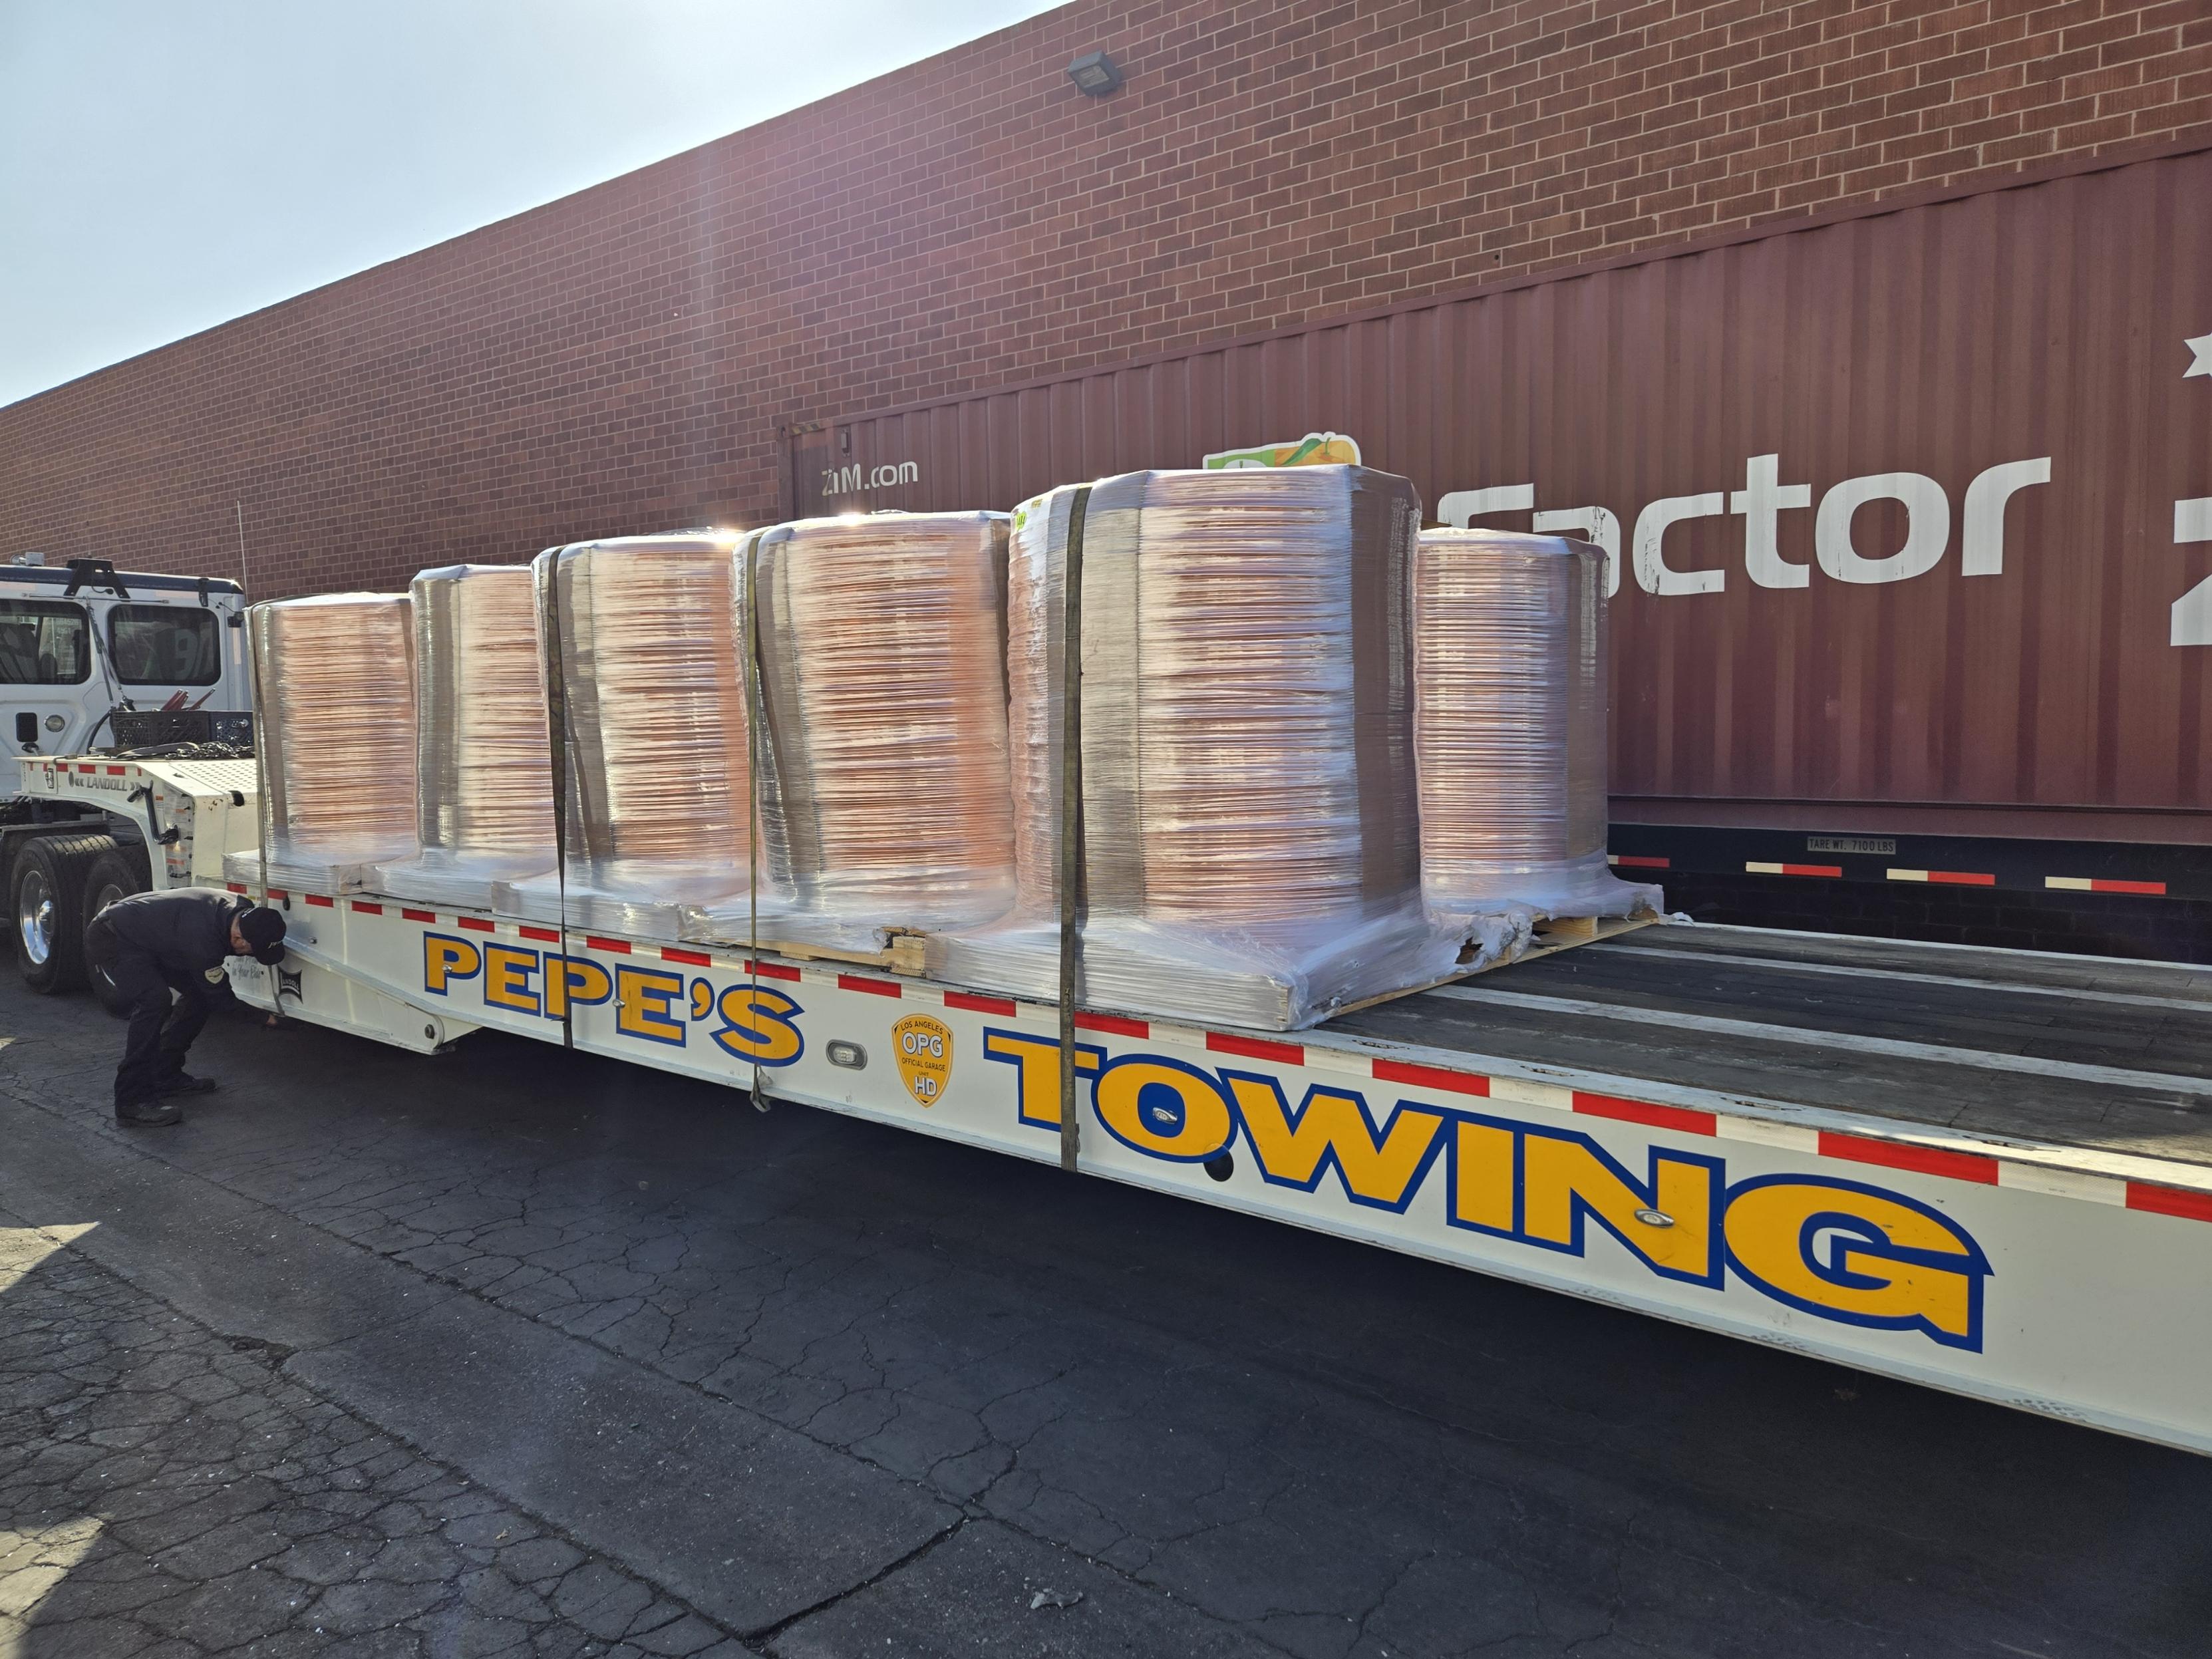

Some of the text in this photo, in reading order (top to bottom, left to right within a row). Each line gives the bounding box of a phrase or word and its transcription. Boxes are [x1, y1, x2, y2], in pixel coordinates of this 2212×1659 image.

[87, 777, 127, 791] LANDOLL
[1810, 839, 1894, 852] TARE WT. 7100 LBS
[423, 931, 805, 1067] PEPE'S
[901, 1020, 943, 1034] LOS ANGELES
[902, 1031, 943, 1058] OPG
[901, 1058, 945, 1072] OFFICIAL GARAGE
[915, 1076, 937, 1096] HD
[983, 1026, 1994, 1354] TOWING
